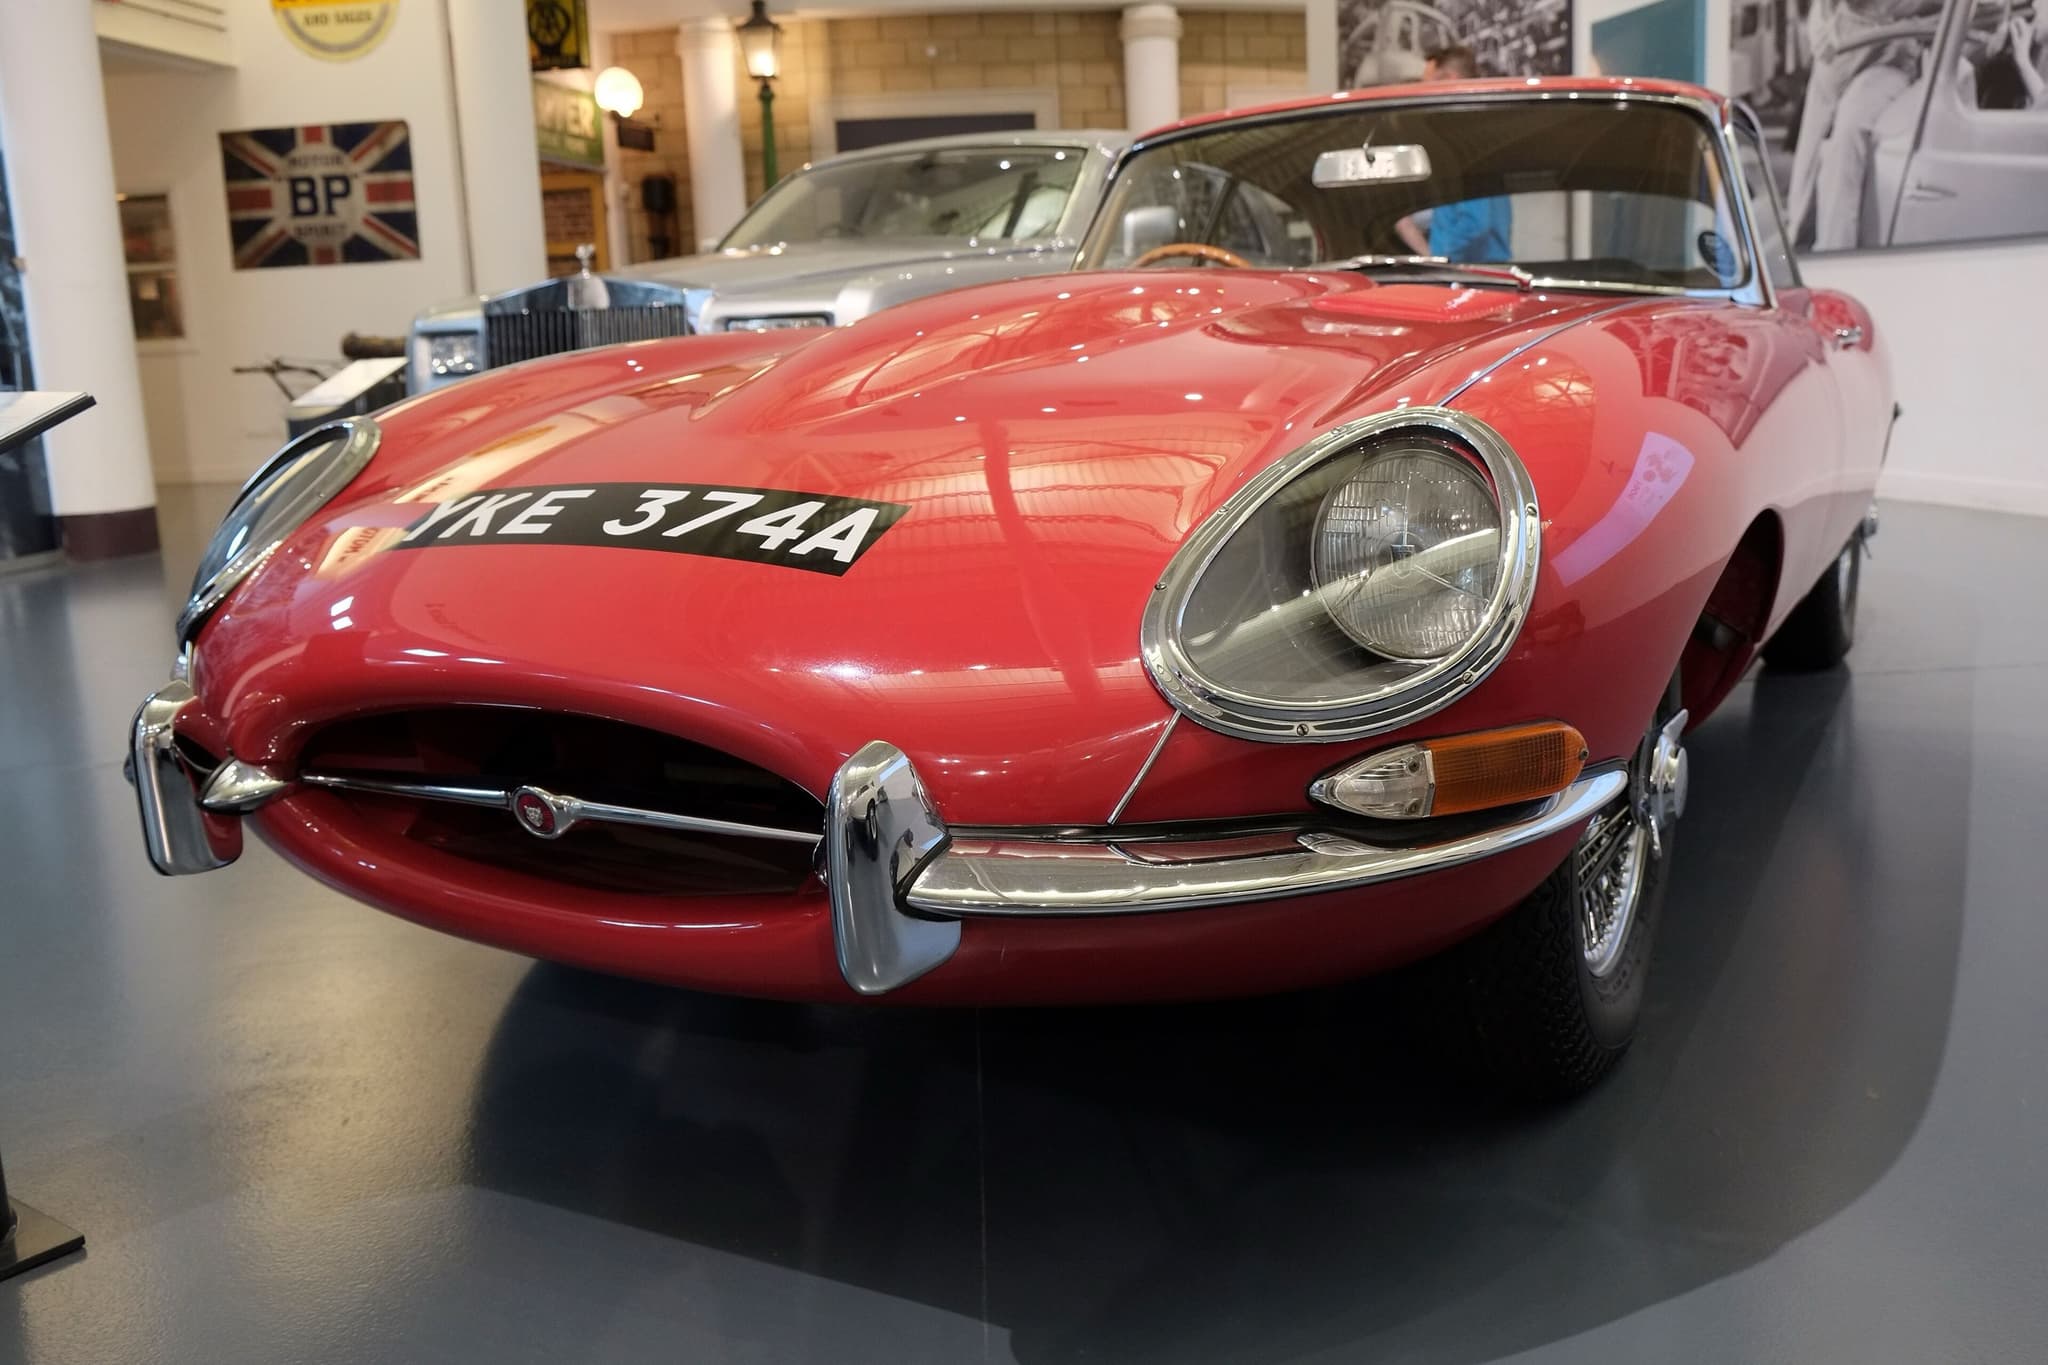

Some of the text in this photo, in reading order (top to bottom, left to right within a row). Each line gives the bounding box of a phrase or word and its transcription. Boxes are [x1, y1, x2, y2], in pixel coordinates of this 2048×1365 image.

[289, 174, 351, 216] BP
[403, 490, 879, 562] YKE 374A
